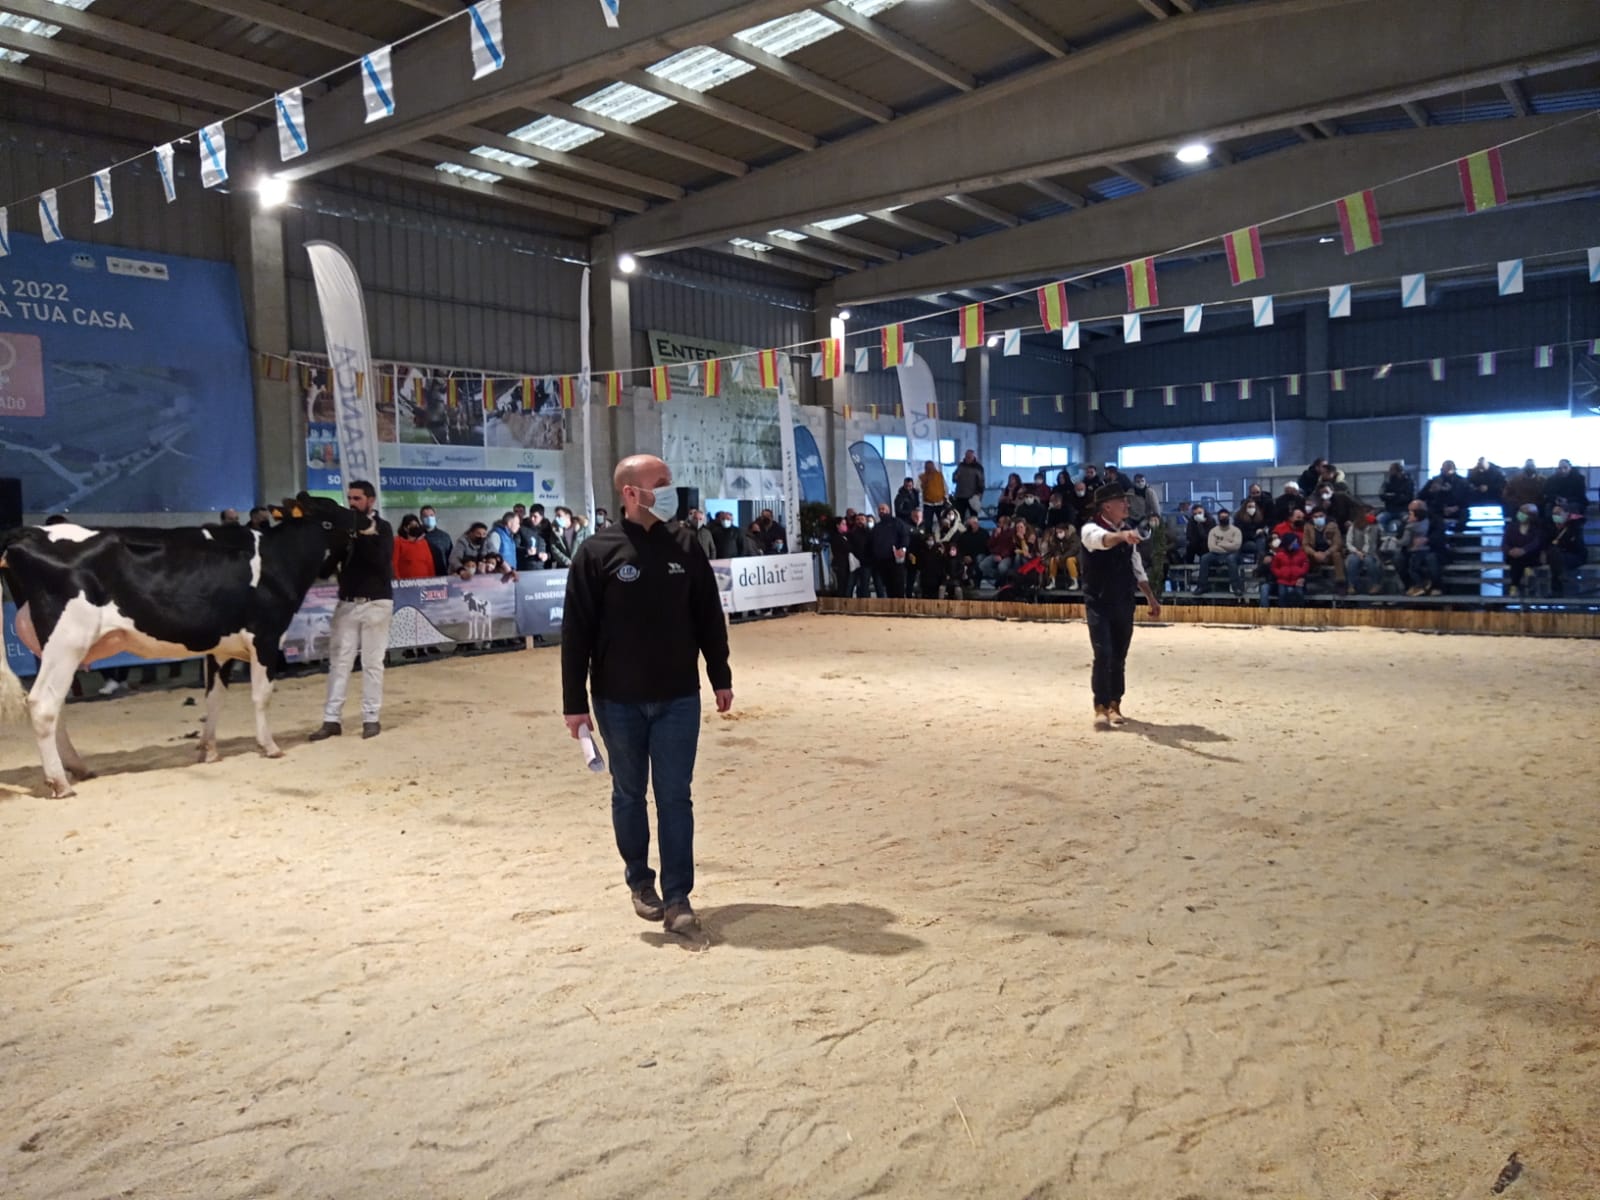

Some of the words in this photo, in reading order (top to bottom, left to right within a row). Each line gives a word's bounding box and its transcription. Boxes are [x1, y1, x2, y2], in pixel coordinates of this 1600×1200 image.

[12, 279, 70, 302] 2022
[16, 301, 68, 324] TUA
[72, 308, 134, 331] CASA
[389, 476, 458, 488] NUTRICIONALES
[459, 476, 518, 488] INTELIGENTES
[739, 564, 786, 588] dellait
